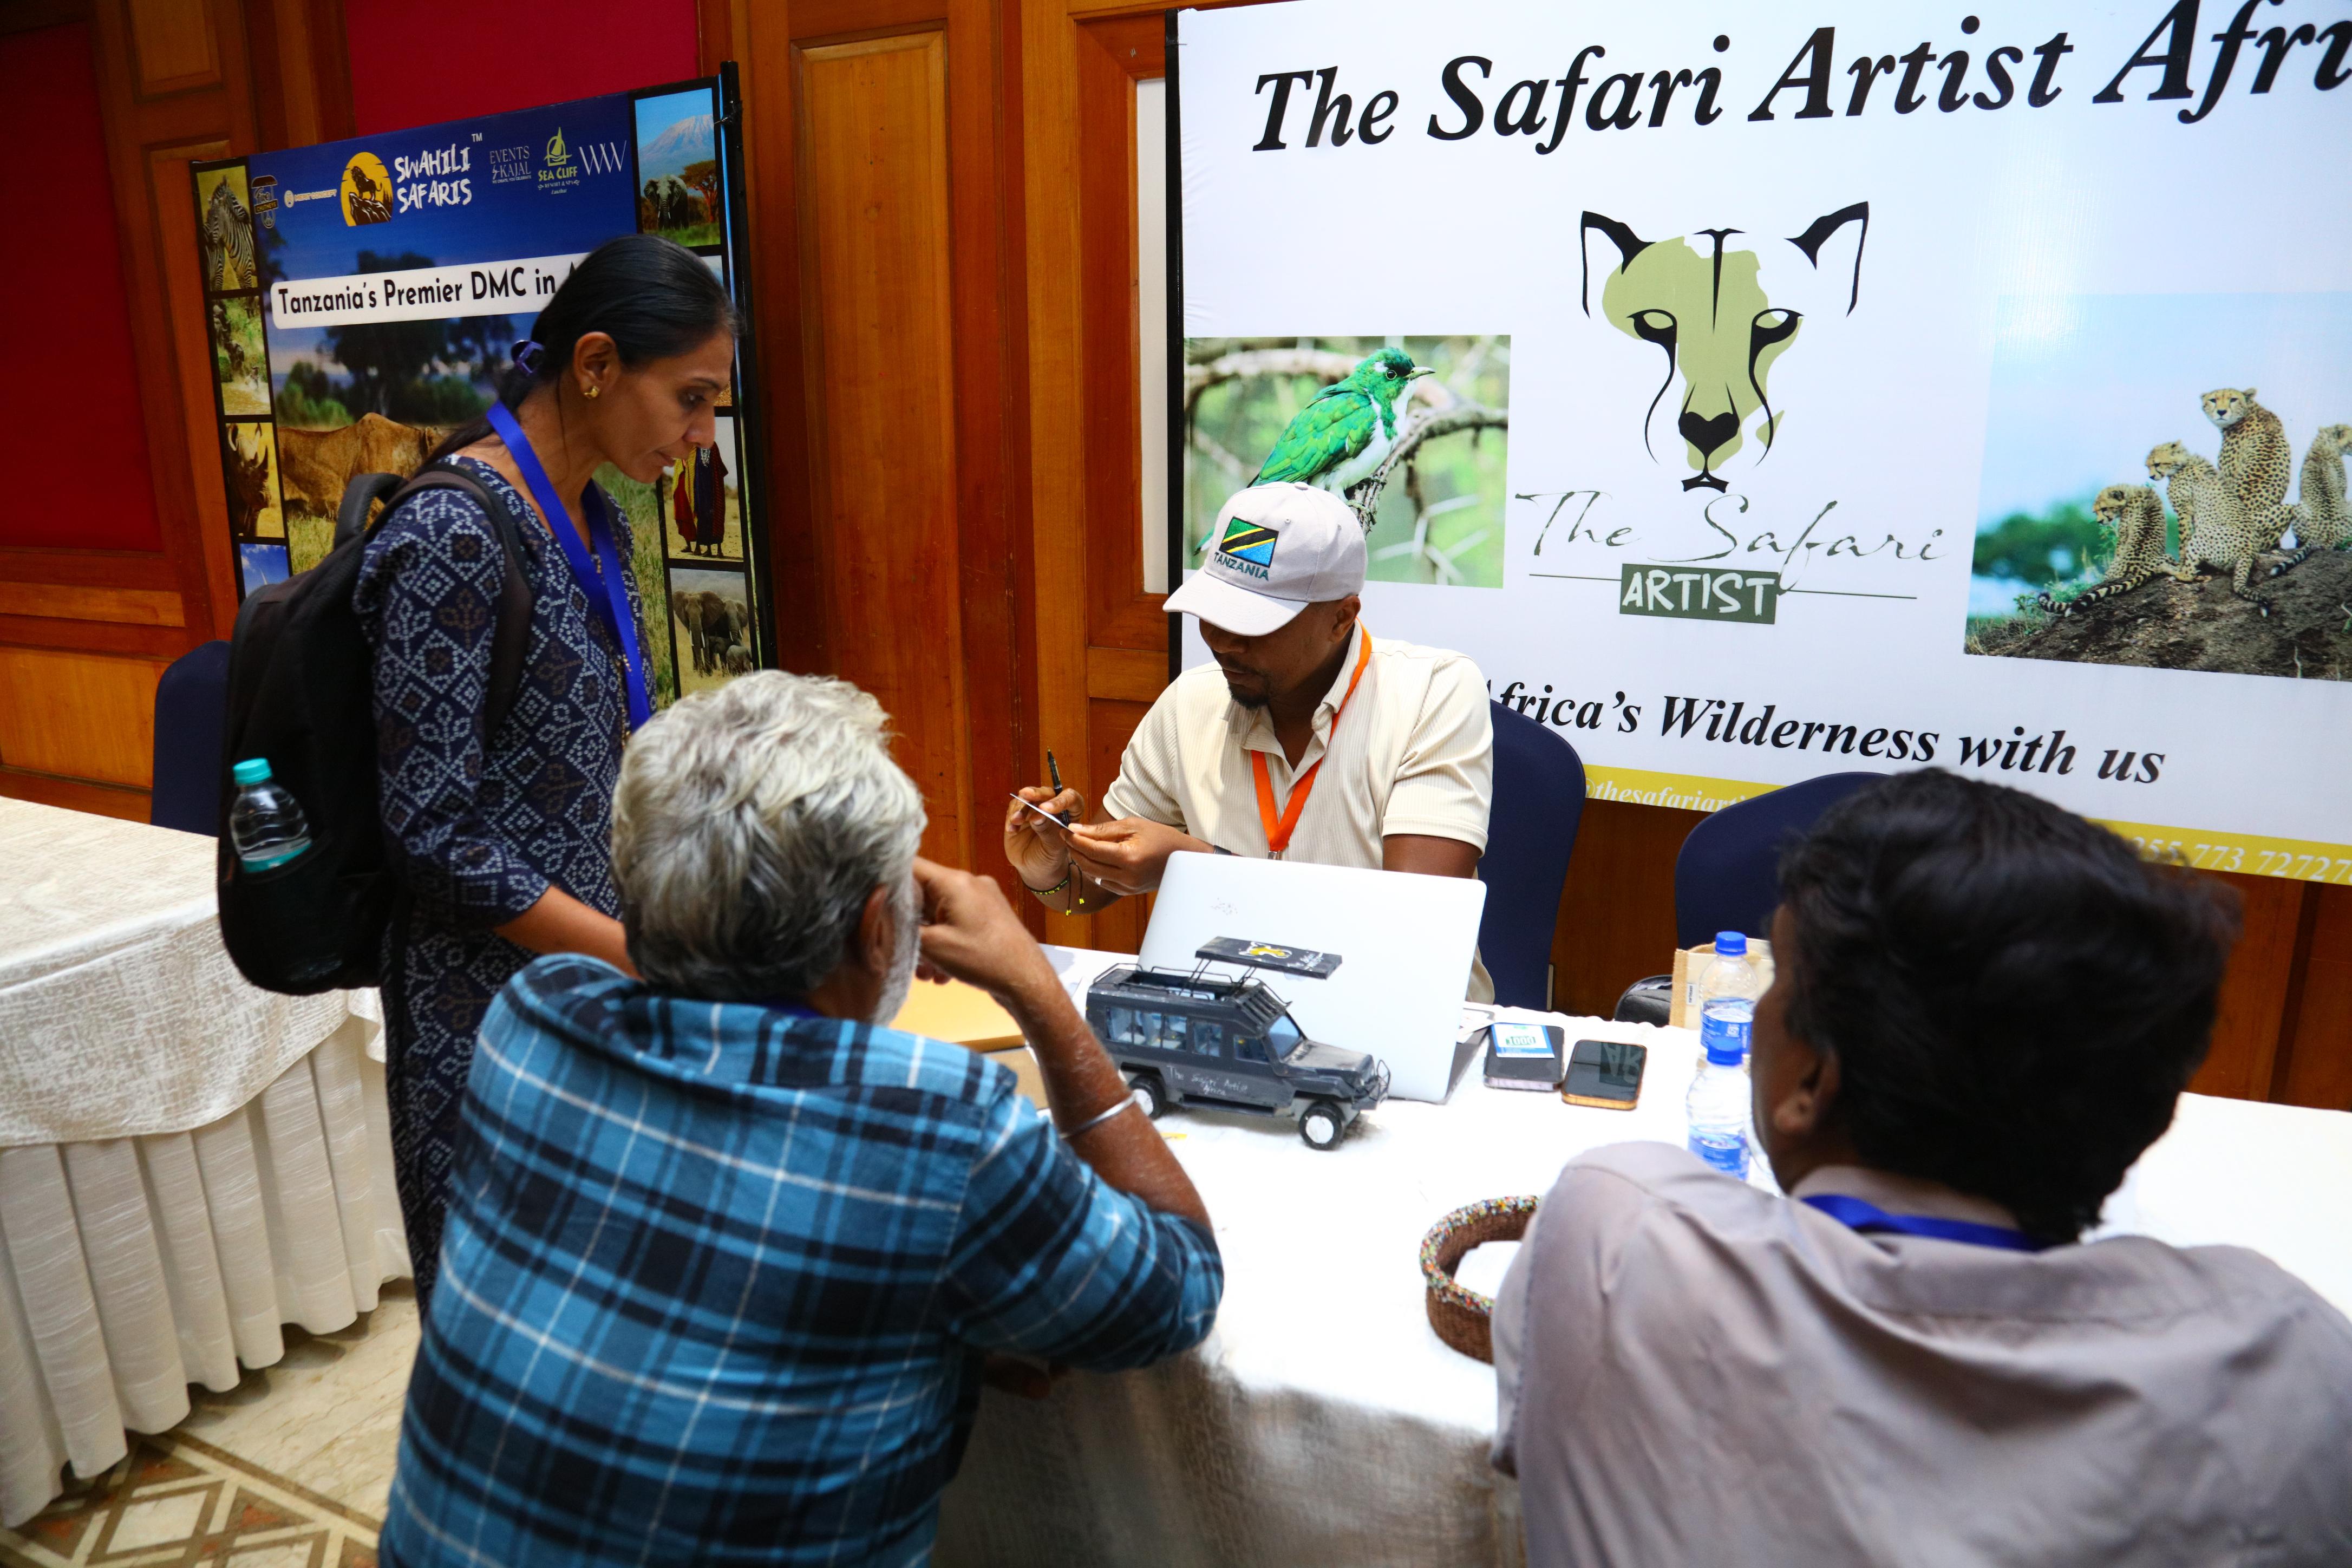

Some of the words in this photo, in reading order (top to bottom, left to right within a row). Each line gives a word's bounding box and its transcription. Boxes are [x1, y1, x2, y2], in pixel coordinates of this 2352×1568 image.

[1252, 66, 1399, 152] The
[1427, 34, 1730, 155] Safari
[1748, 15, 2074, 122] Artist
[471, 132, 482, 142] TM
[489, 146, 530, 164] EVENTS
[394, 143, 471, 183] SWAHILI
[500, 161, 532, 178] KAJAL
[538, 169, 555, 181] SEA
[556, 166, 578, 179] CLIFF
[397, 178, 472, 213] SAFARIS
[278, 282, 377, 314] Tanzania's
[383, 278, 462, 306] Premier
[471, 266, 527, 300] DMC
[535, 268, 556, 295] in
[1515, 491, 1642, 557] The
[1647, 494, 1949, 596] Safari
[1213, 552, 1270, 582] TANZANIA
[1622, 569, 1776, 617] ARTIST
[1487, 678, 1642, 733] frica's
[1661, 695, 1941, 762] Wilderness
[1959, 726, 2077, 775] with
[2097, 748, 2166, 784] us
[2191, 844, 2245, 871] 773
[2255, 851, 2352, 886] 72727
